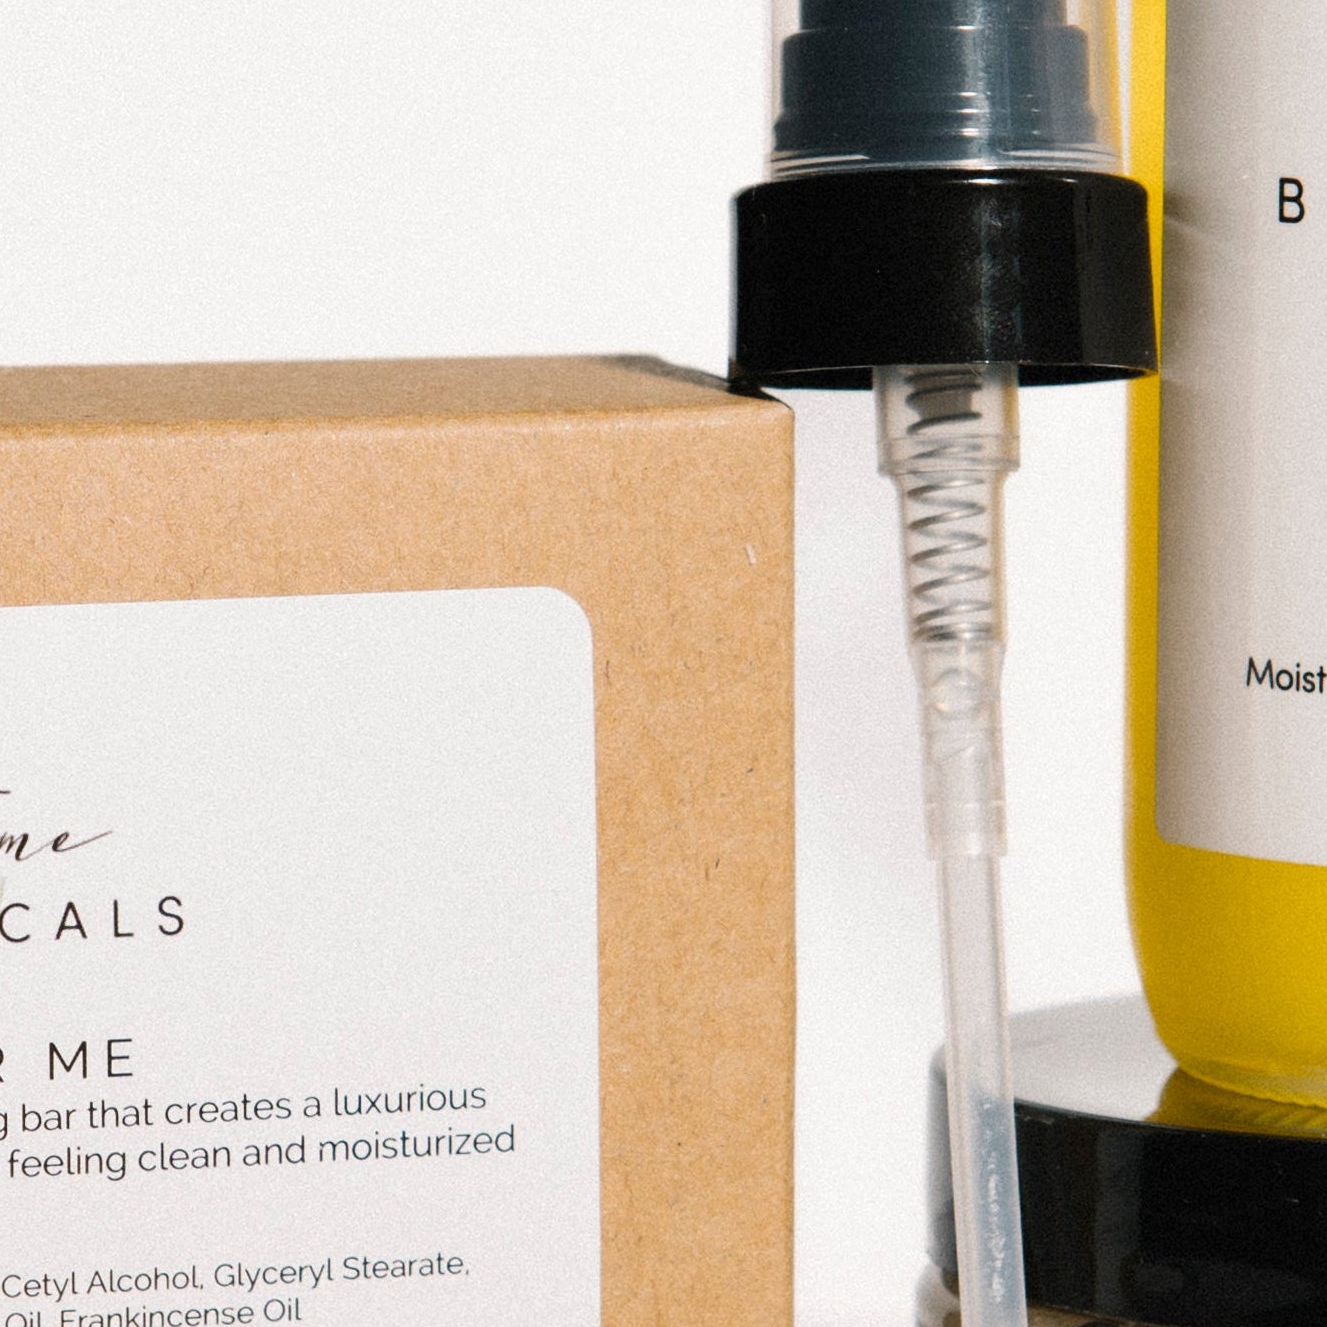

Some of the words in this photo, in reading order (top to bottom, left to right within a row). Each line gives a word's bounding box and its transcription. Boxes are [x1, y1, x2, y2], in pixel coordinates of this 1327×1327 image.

[48, 1038, 133, 1081] ME
[21, 1103, 76, 1132] bar
[87, 1098, 154, 1129] that
[164, 1093, 292, 1125] creates
[303, 1096, 322, 1118] a
[334, 1083, 487, 1116] luxurious
[8, 1146, 127, 1182] feeling
[138, 1142, 231, 1172] clean
[242, 1135, 306, 1167] and
[319, 1124, 515, 1162] moisturized
[1, 1271, 78, 1303] Cetyl
[86, 1265, 204, 1294] Alcohol,
[214, 1258, 334, 1293] Glyceryl
[343, 1252, 469, 1280] Stearate,
[263, 1298, 302, 1322] Oil
